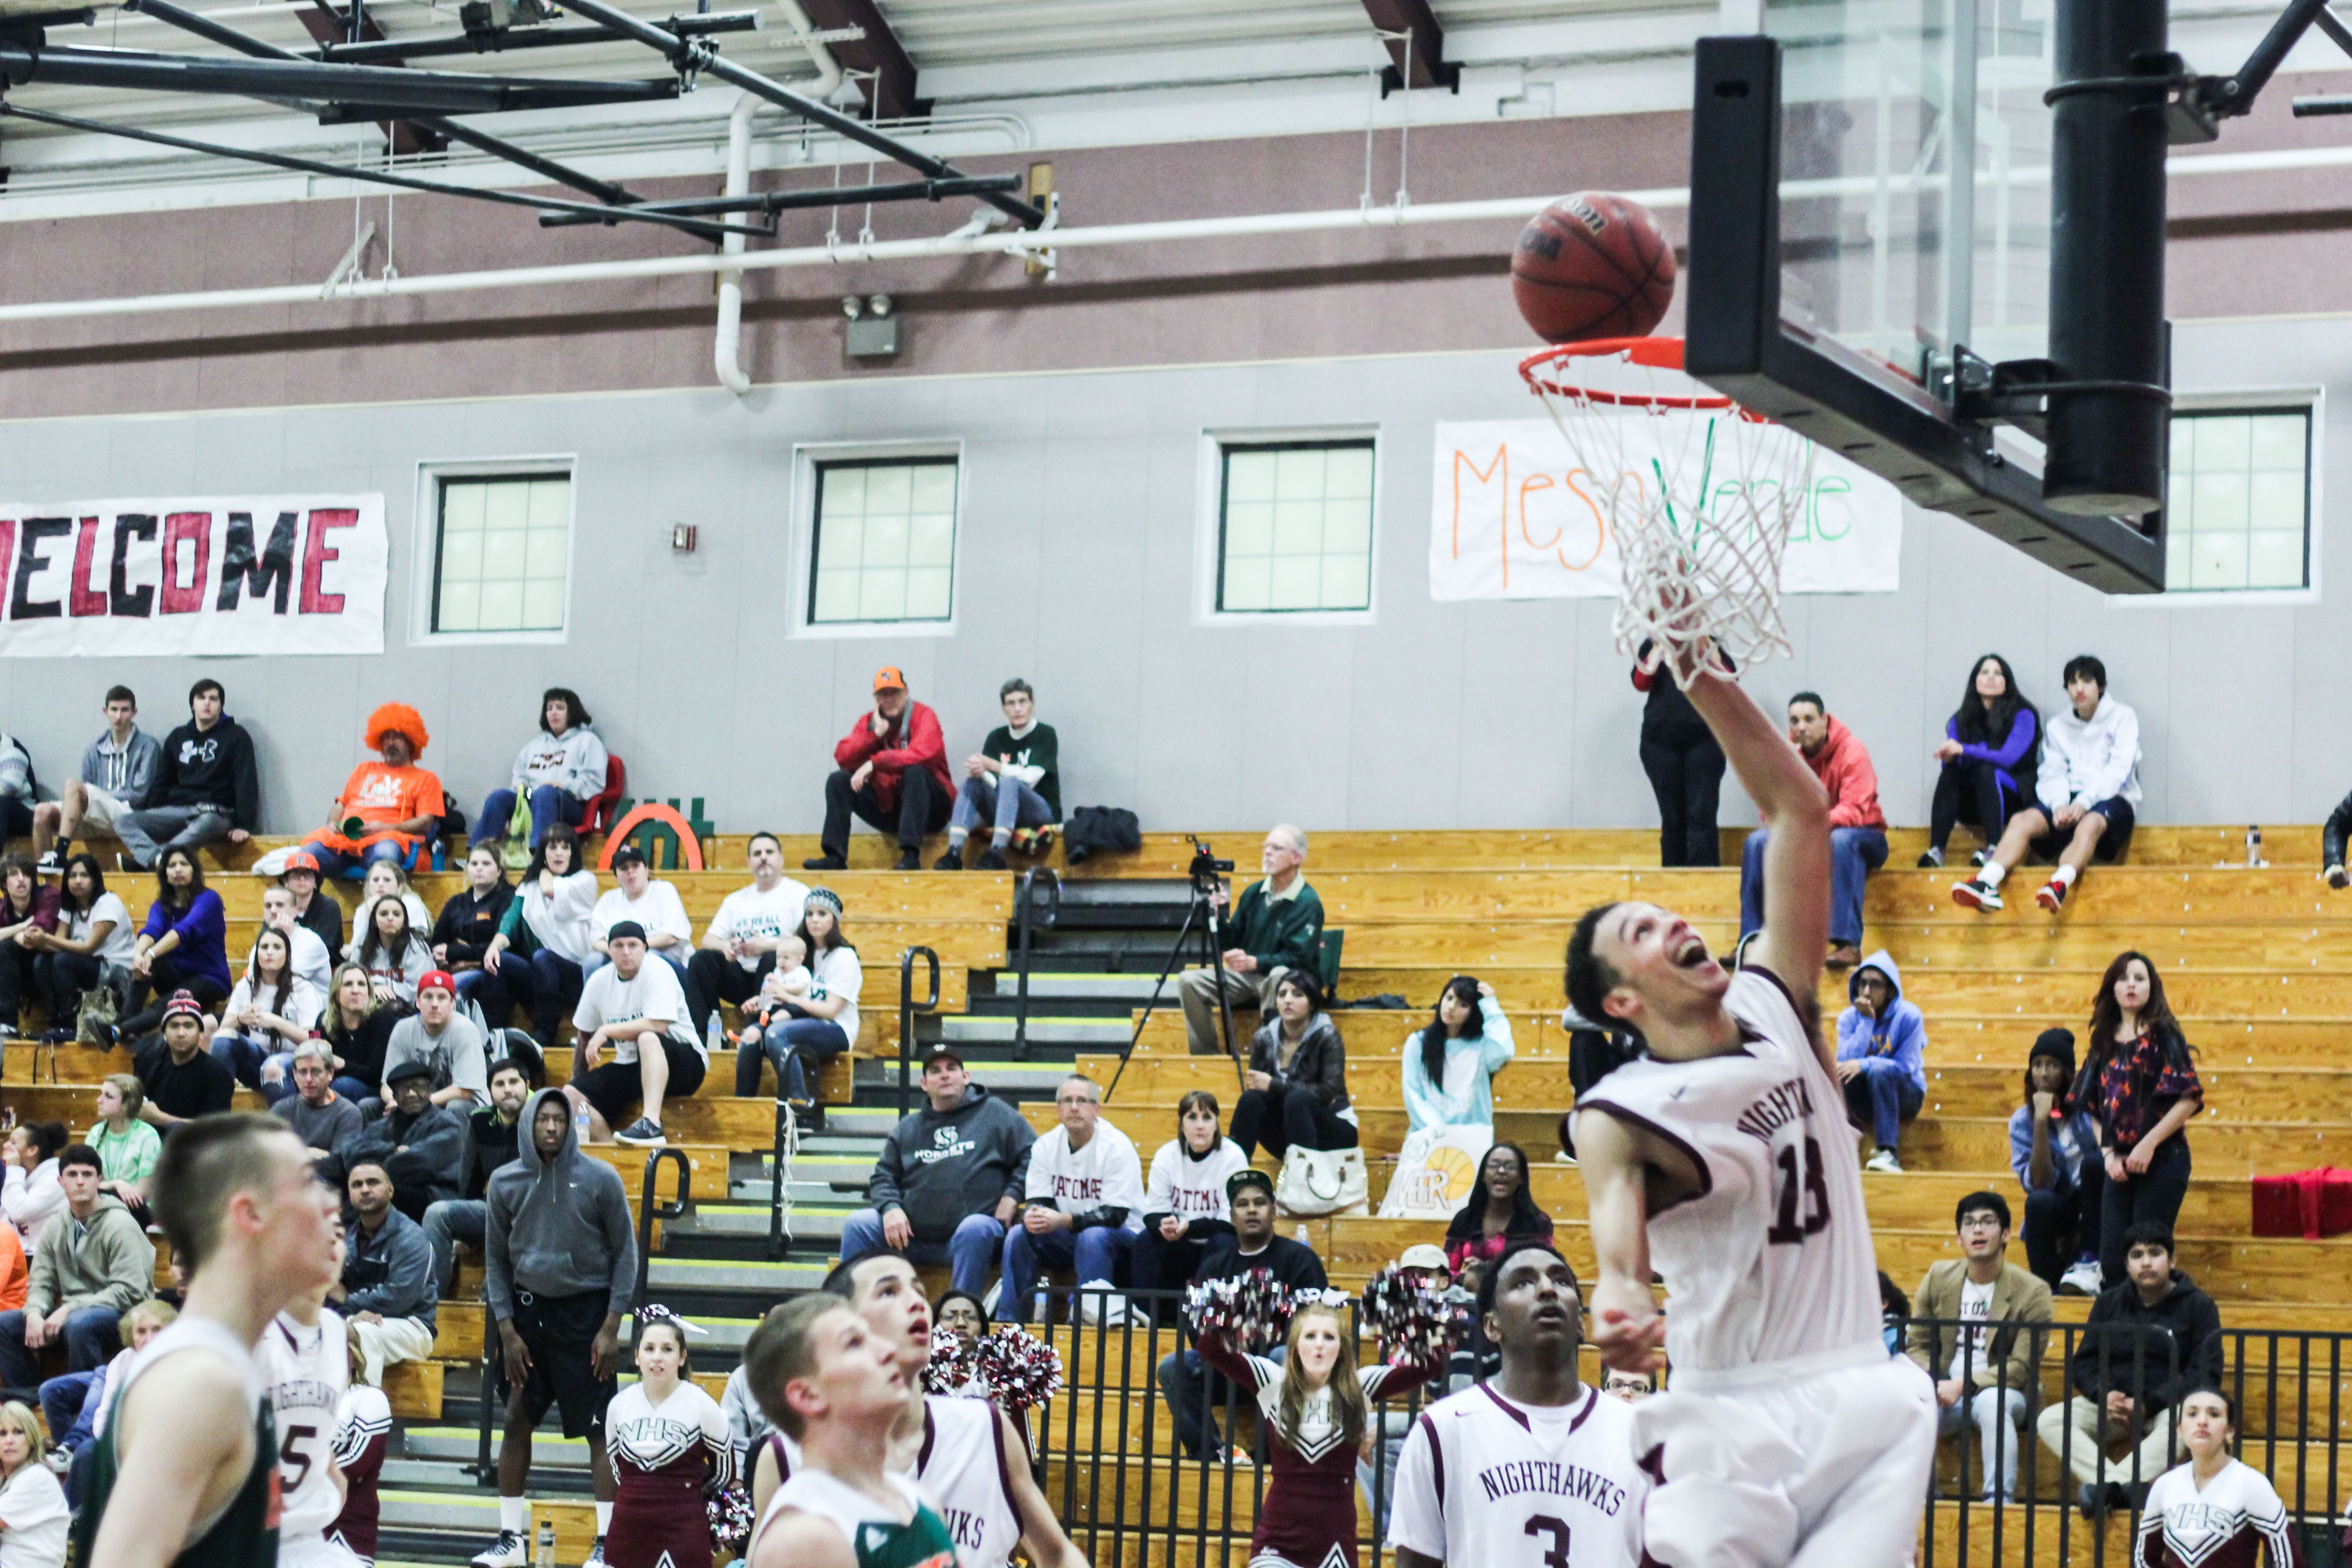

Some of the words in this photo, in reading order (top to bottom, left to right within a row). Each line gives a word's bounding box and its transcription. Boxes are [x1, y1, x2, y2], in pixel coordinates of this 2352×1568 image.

[1454, 442, 1645, 589] Mesa
[1652, 417, 1852, 571] Verde
[280, 1425, 317, 1493] 5
[620, 1417, 690, 1446] NHS
[1480, 1460, 1626, 1516] NIGHTHAWKS
[1524, 1514, 1570, 1568] 3
[2165, 1503, 2235, 1539] NHS
